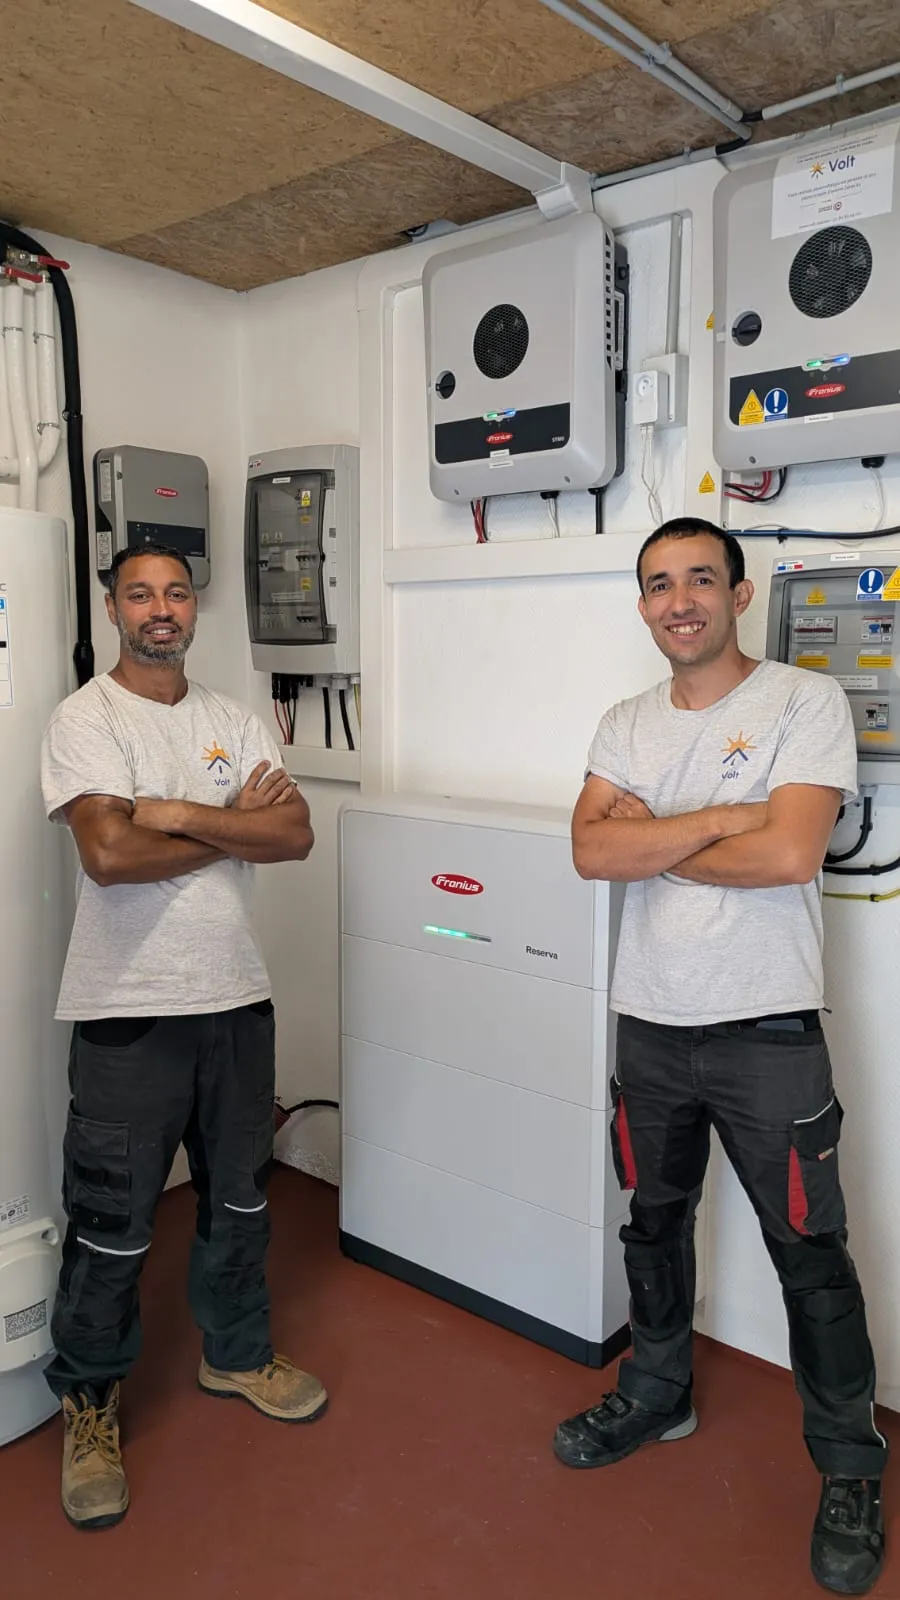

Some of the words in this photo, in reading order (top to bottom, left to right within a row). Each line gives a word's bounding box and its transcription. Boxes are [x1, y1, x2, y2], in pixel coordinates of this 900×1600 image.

[829, 155, 855, 172] Volt
[722, 770, 740, 780] Volt
[435, 875, 480, 892] Fronius
[526, 945, 558, 960] Reserva
